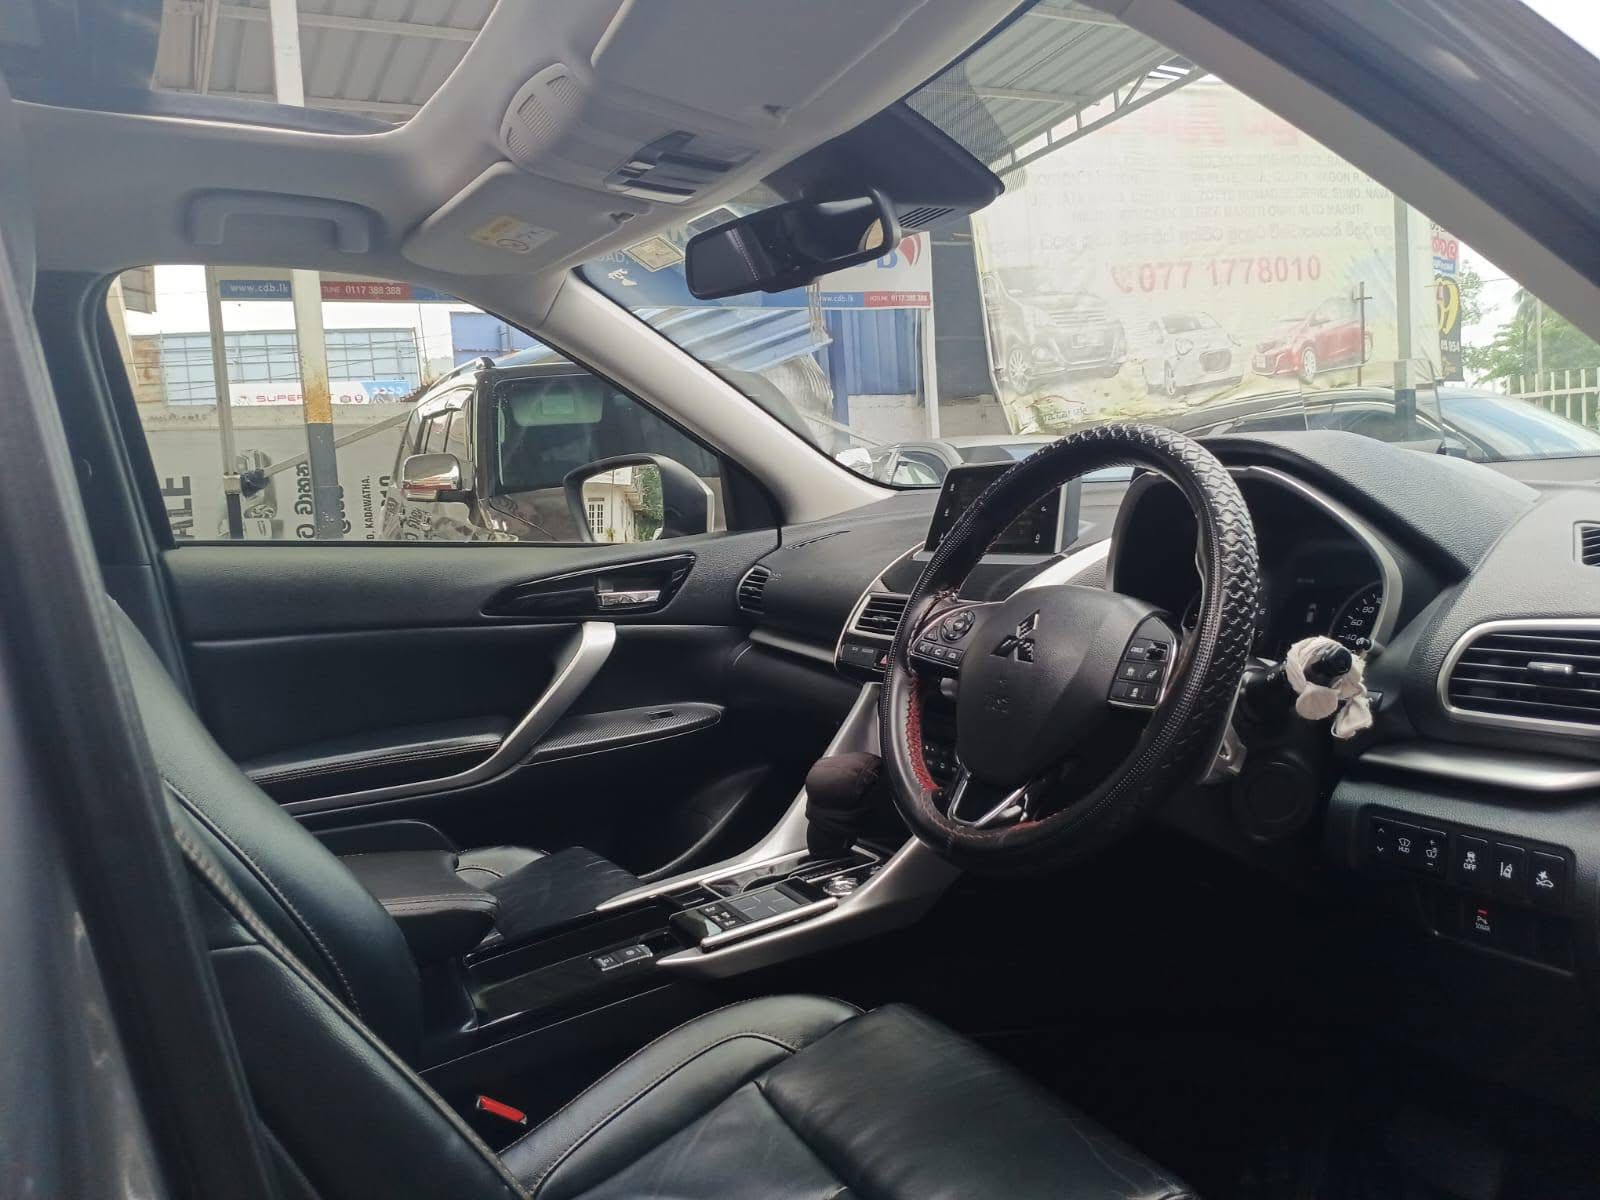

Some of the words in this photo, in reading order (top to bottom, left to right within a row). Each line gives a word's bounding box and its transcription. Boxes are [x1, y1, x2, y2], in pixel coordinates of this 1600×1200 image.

[1138, 261, 1193, 293] 077
[1205, 254, 1322, 287] 1778010
[230, 282, 289, 293] www.cdb.lk
[361, 475, 373, 529] KADAWATHA.
[1463, 862, 1477, 871] OFF
